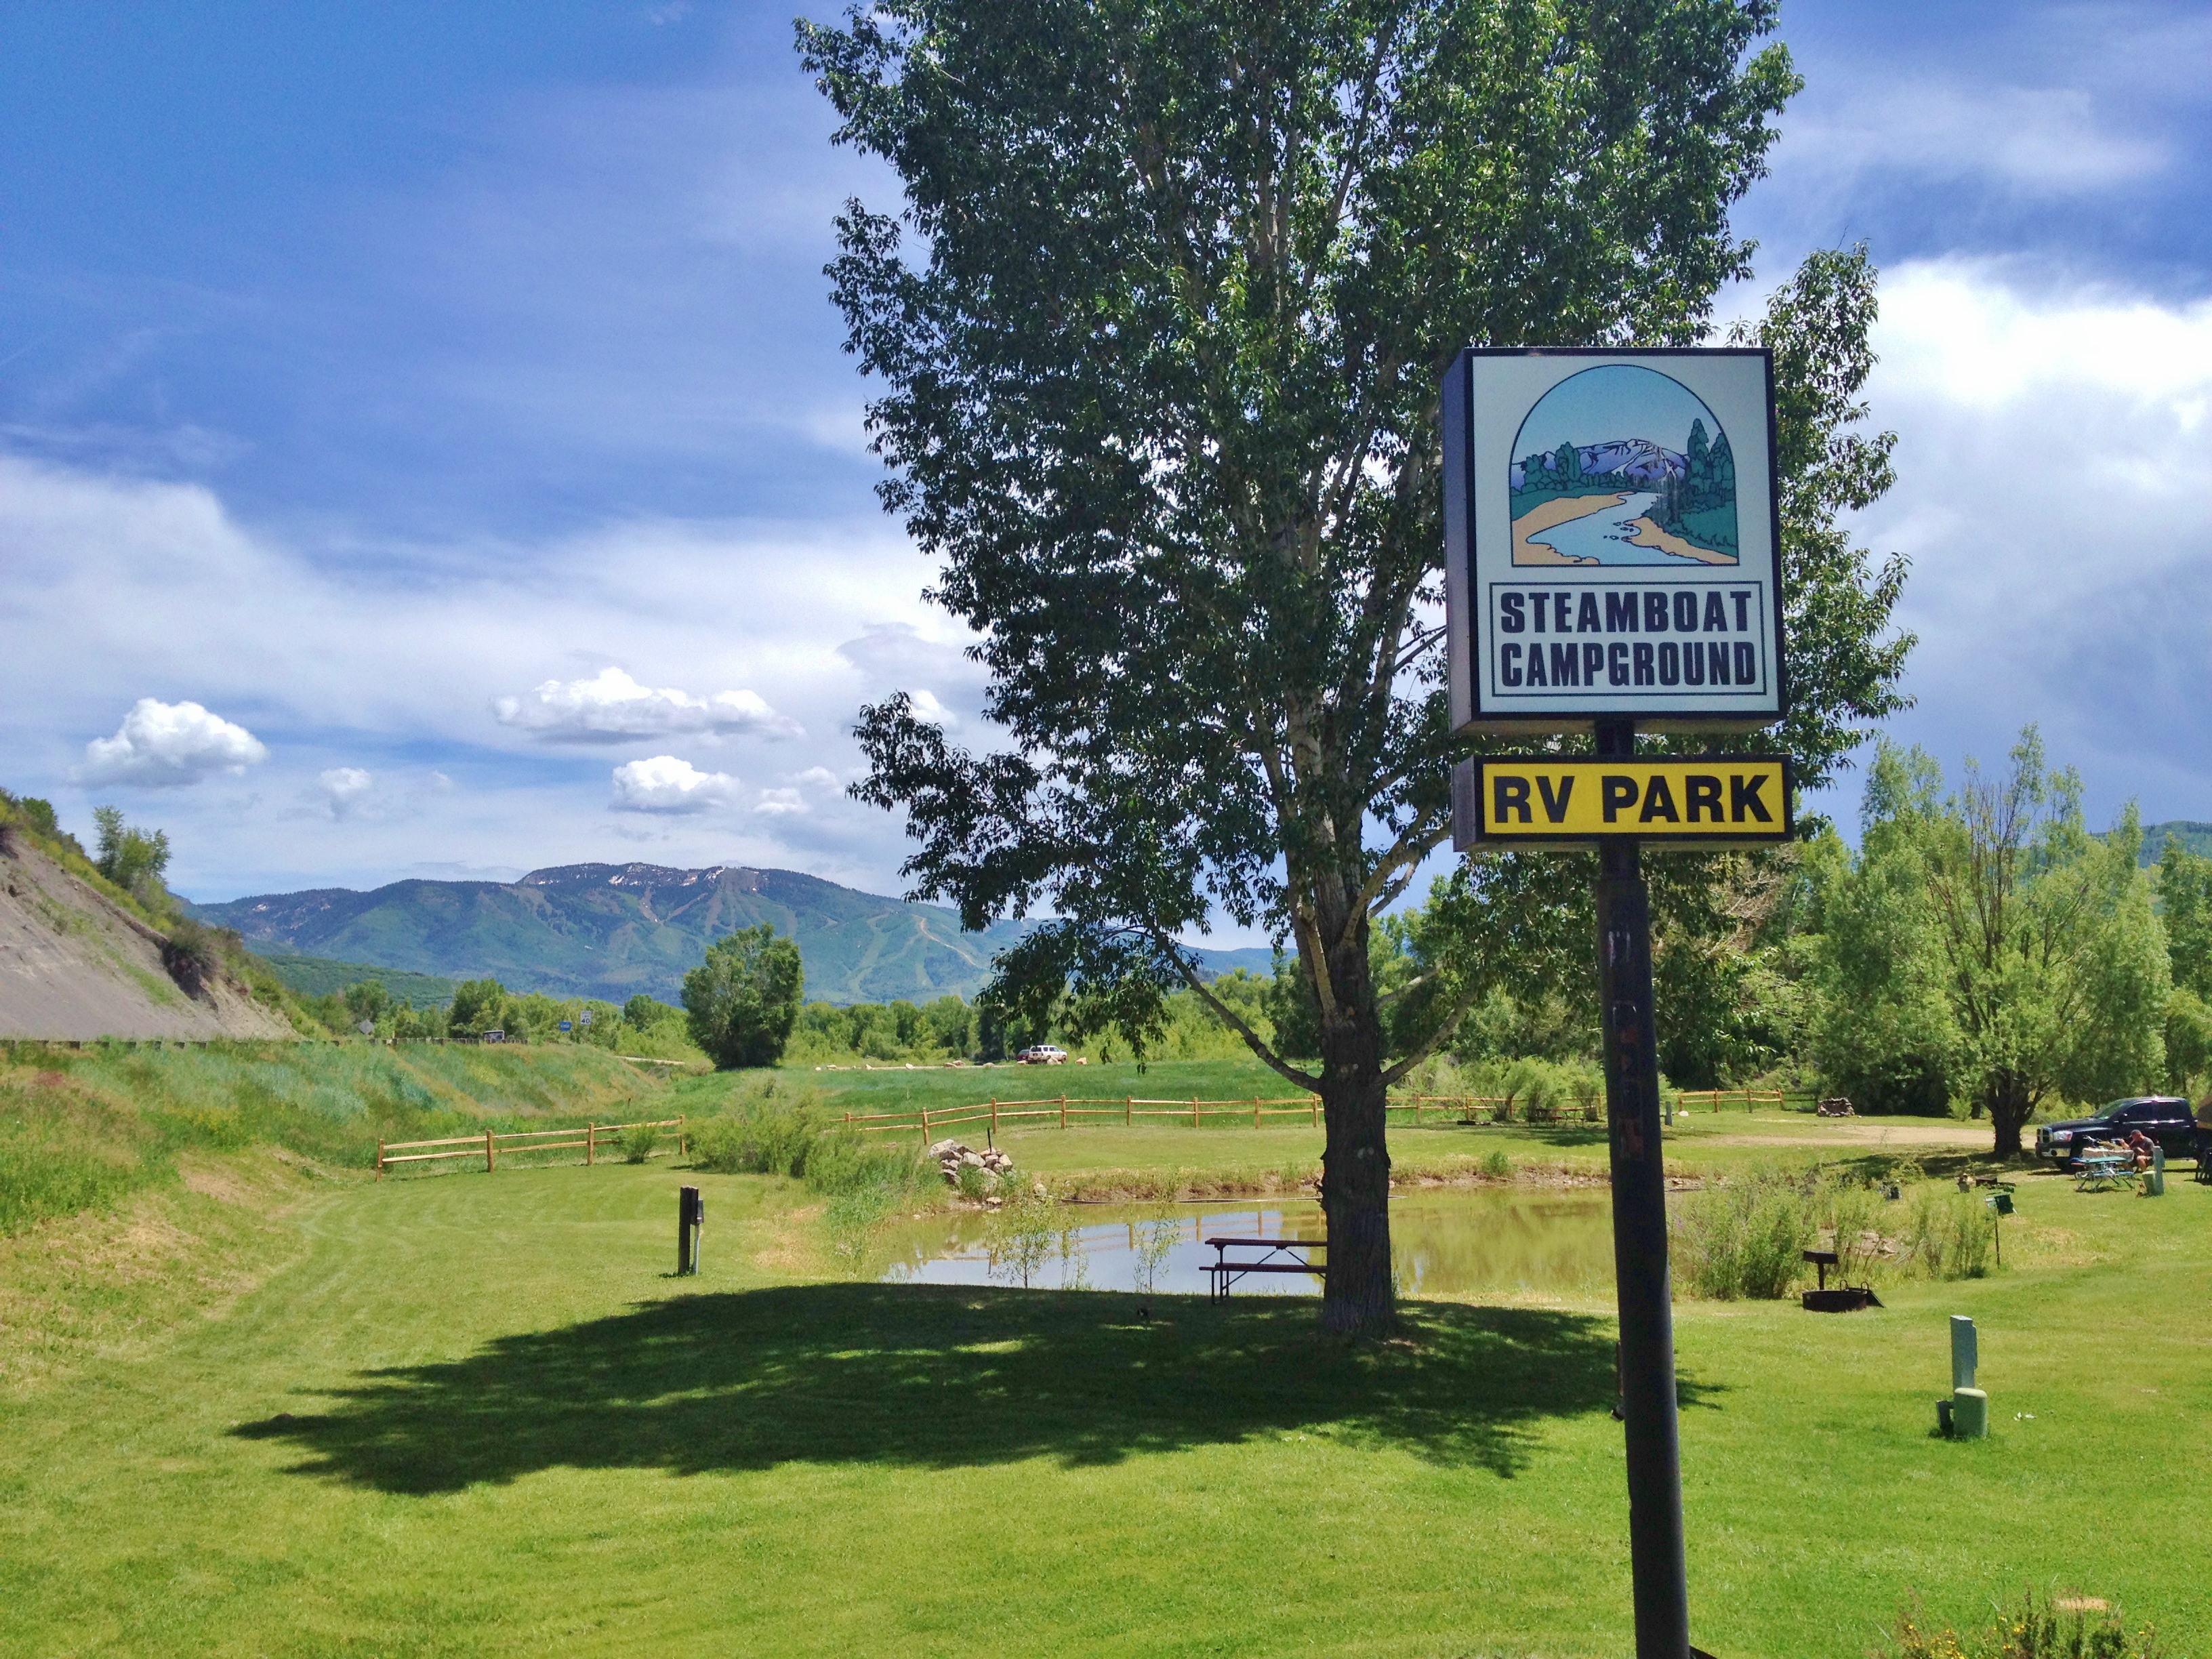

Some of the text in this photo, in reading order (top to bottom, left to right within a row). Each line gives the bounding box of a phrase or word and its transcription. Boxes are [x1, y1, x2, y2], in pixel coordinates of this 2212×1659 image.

[1500, 591, 1752, 634] STEAMBOAT
[1500, 641, 1756, 687] CAMPGROUND
[1493, 774, 1774, 823] RV PARK
